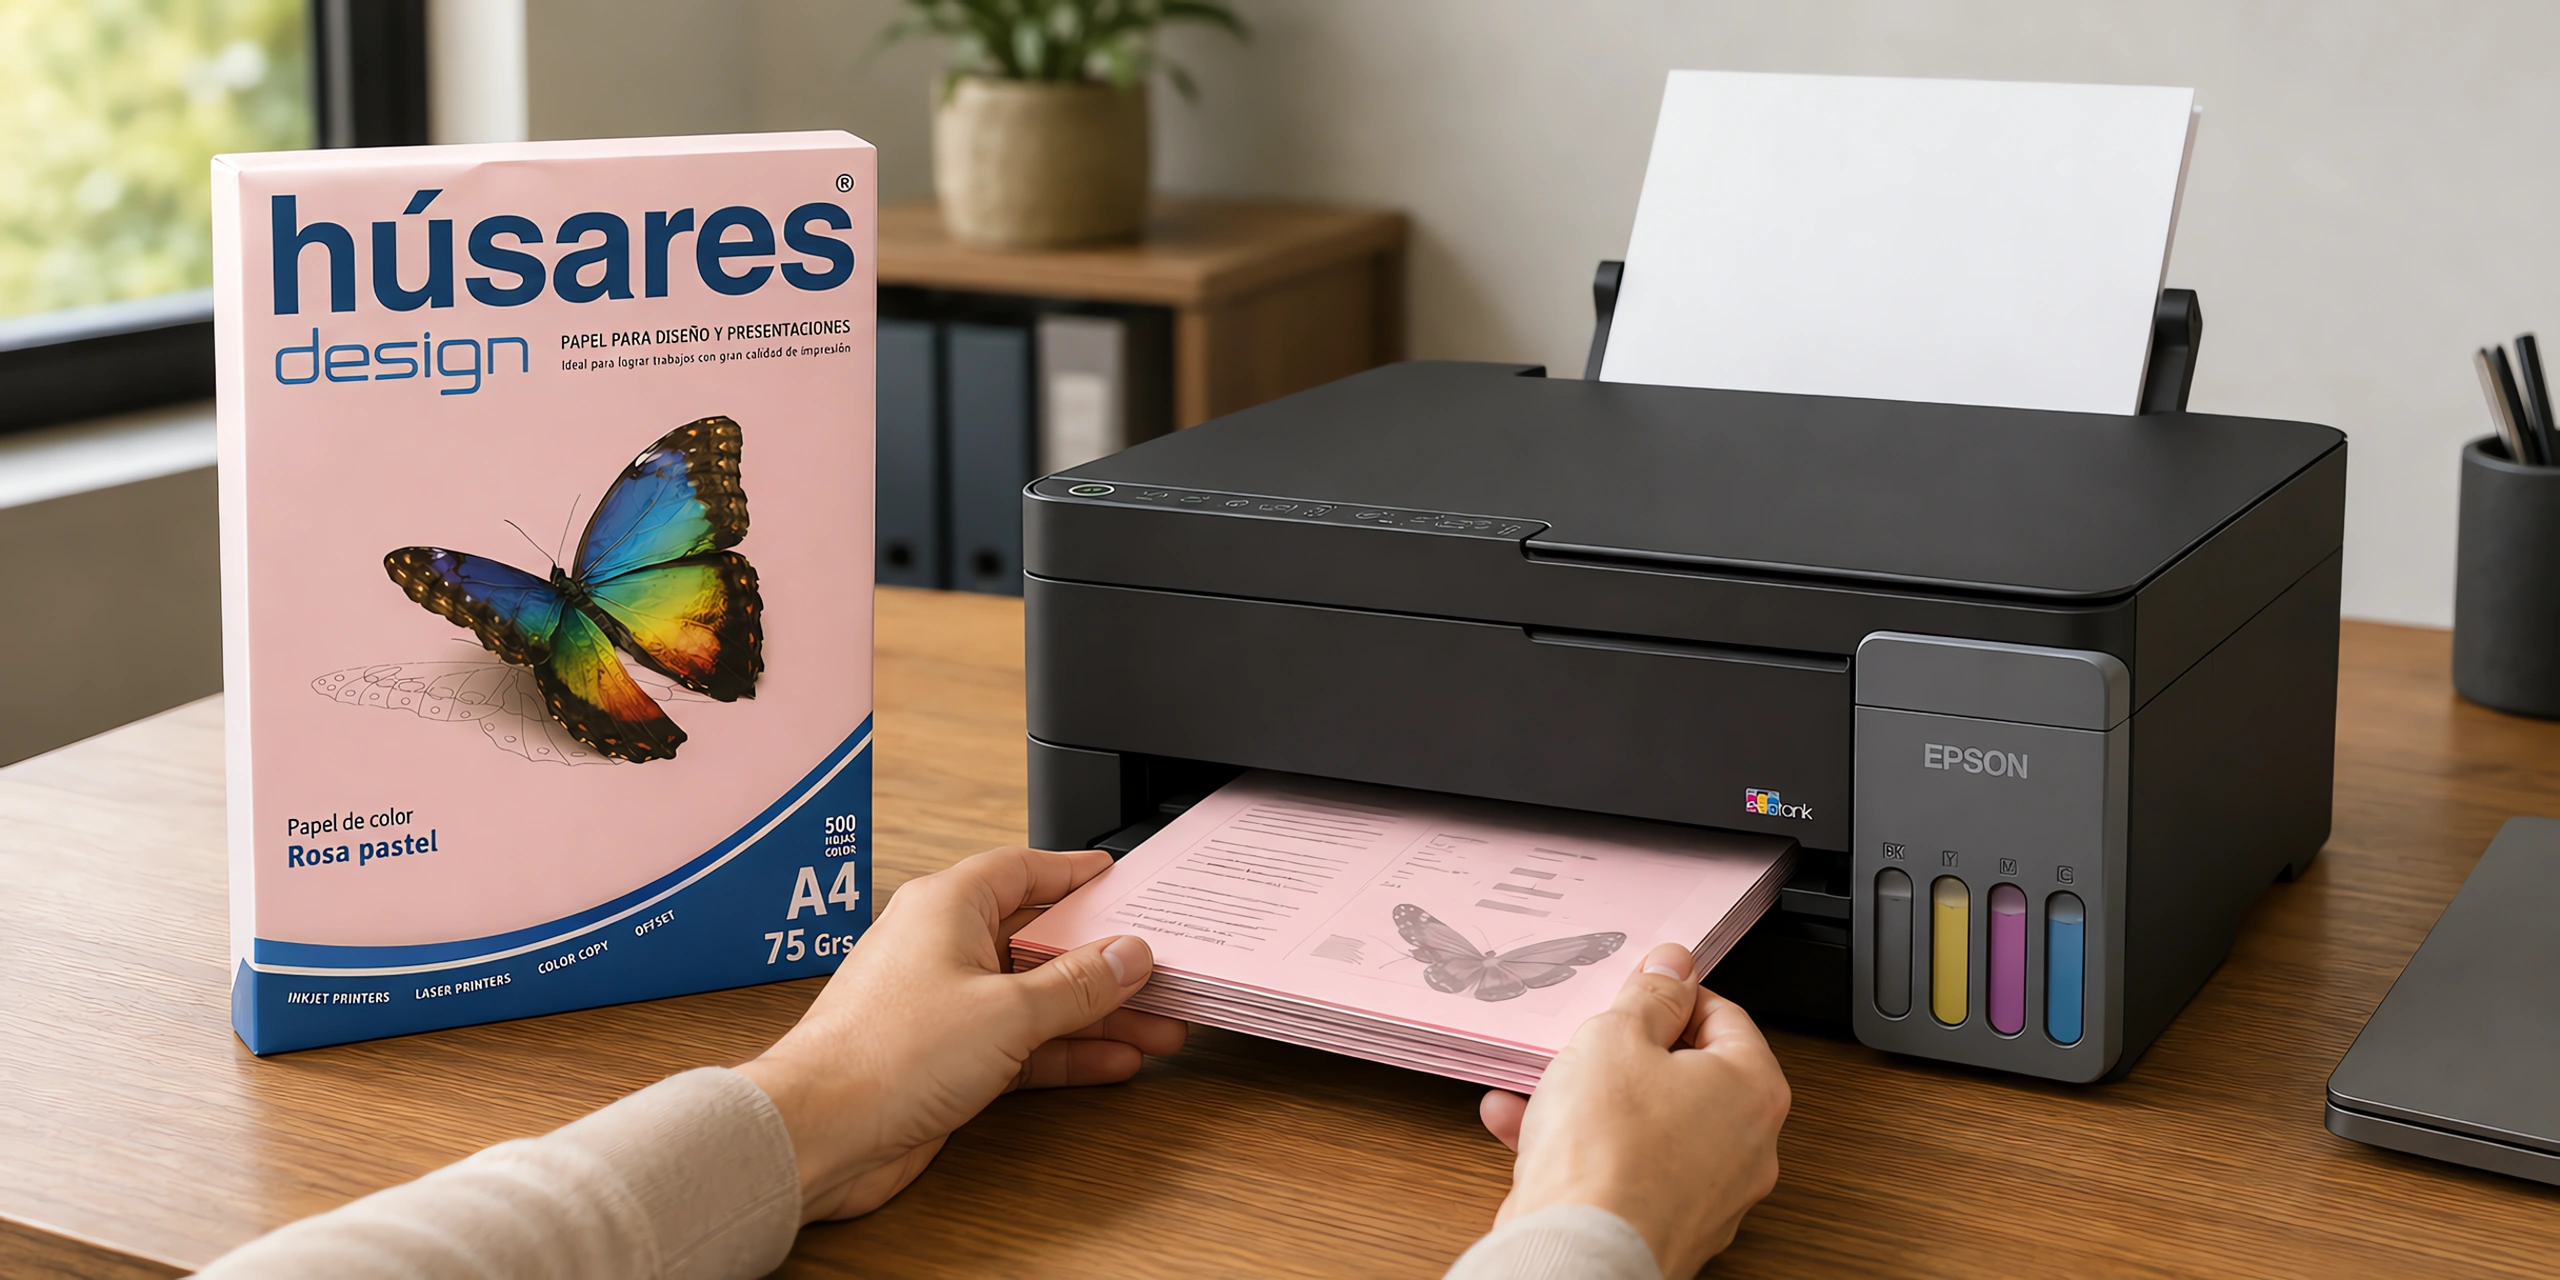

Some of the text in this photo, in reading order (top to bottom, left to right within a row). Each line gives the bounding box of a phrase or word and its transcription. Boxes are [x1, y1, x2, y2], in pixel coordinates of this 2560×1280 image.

[271, 188, 855, 316] húsares
[561, 319, 851, 350] PAPEL PARA DISEÑO Y PRESENTACIONES
[275, 326, 530, 396] design
[561, 358, 588, 371] Ideal
[591, 358, 615, 372] para
[618, 356, 650, 370] lograr
[653, 352, 695, 367] trabajos
[698, 352, 716, 363] con
[719, 351, 743, 365] gran
[746, 346, 783, 360] calidad
[786, 345, 798, 358] de
[1923, 742, 2029, 780] EPSON
[288, 807, 414, 839] Papel de color
[824, 814, 856, 835] 500
[288, 828, 439, 868] Rosa pastel
[824, 845, 857, 858] COLOR
[1943, 851, 1958, 867] Y
[2001, 859, 2016, 875] M
[2059, 867, 2074, 884] C
[785, 861, 860, 921] A4
[634, 909, 676, 937] OFFSET
[537, 939, 609, 975] COLOR COPY
[764, 927, 806, 965] 75
[287, 991, 391, 1005] INKJET PRINTERS
[415, 972, 512, 1000] LASER PRINTERS
